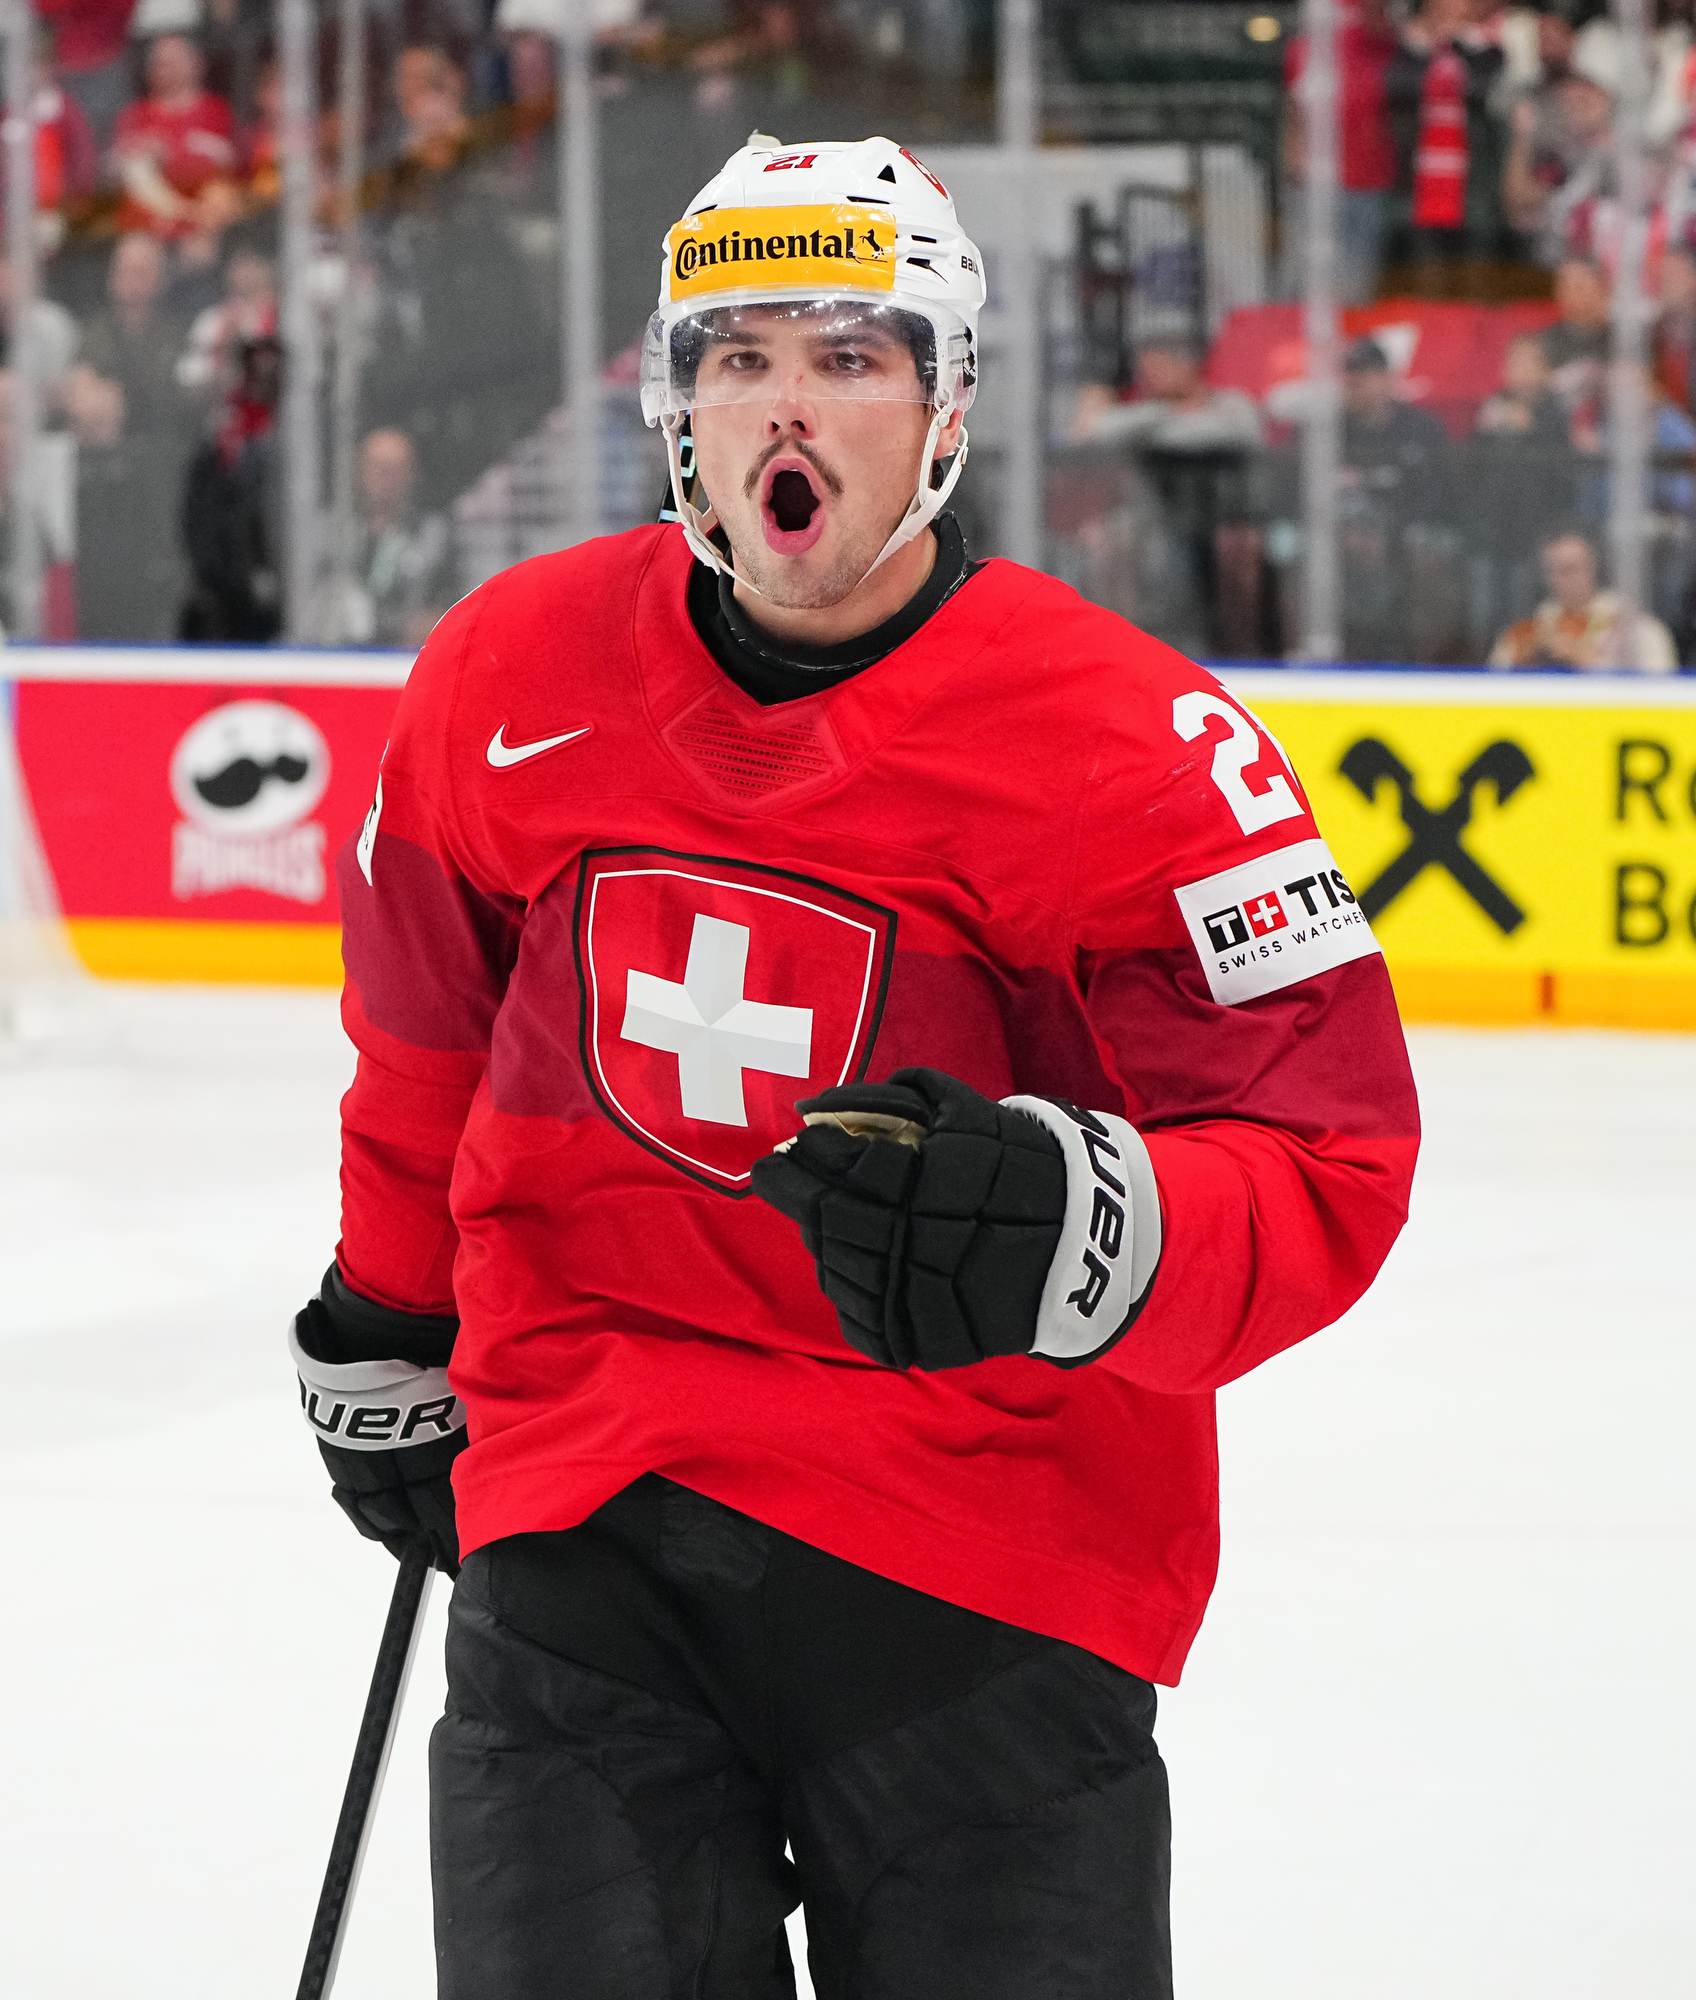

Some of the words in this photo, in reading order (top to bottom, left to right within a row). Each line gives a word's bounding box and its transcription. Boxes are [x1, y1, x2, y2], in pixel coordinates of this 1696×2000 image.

[763, 154, 818, 172] 21
[675, 228, 856, 280] Continental
[1172, 685, 1306, 837] 2
[1616, 738, 1696, 823] R
[1616, 863, 1696, 947] B
[1219, 940, 1283, 974] SWISS
